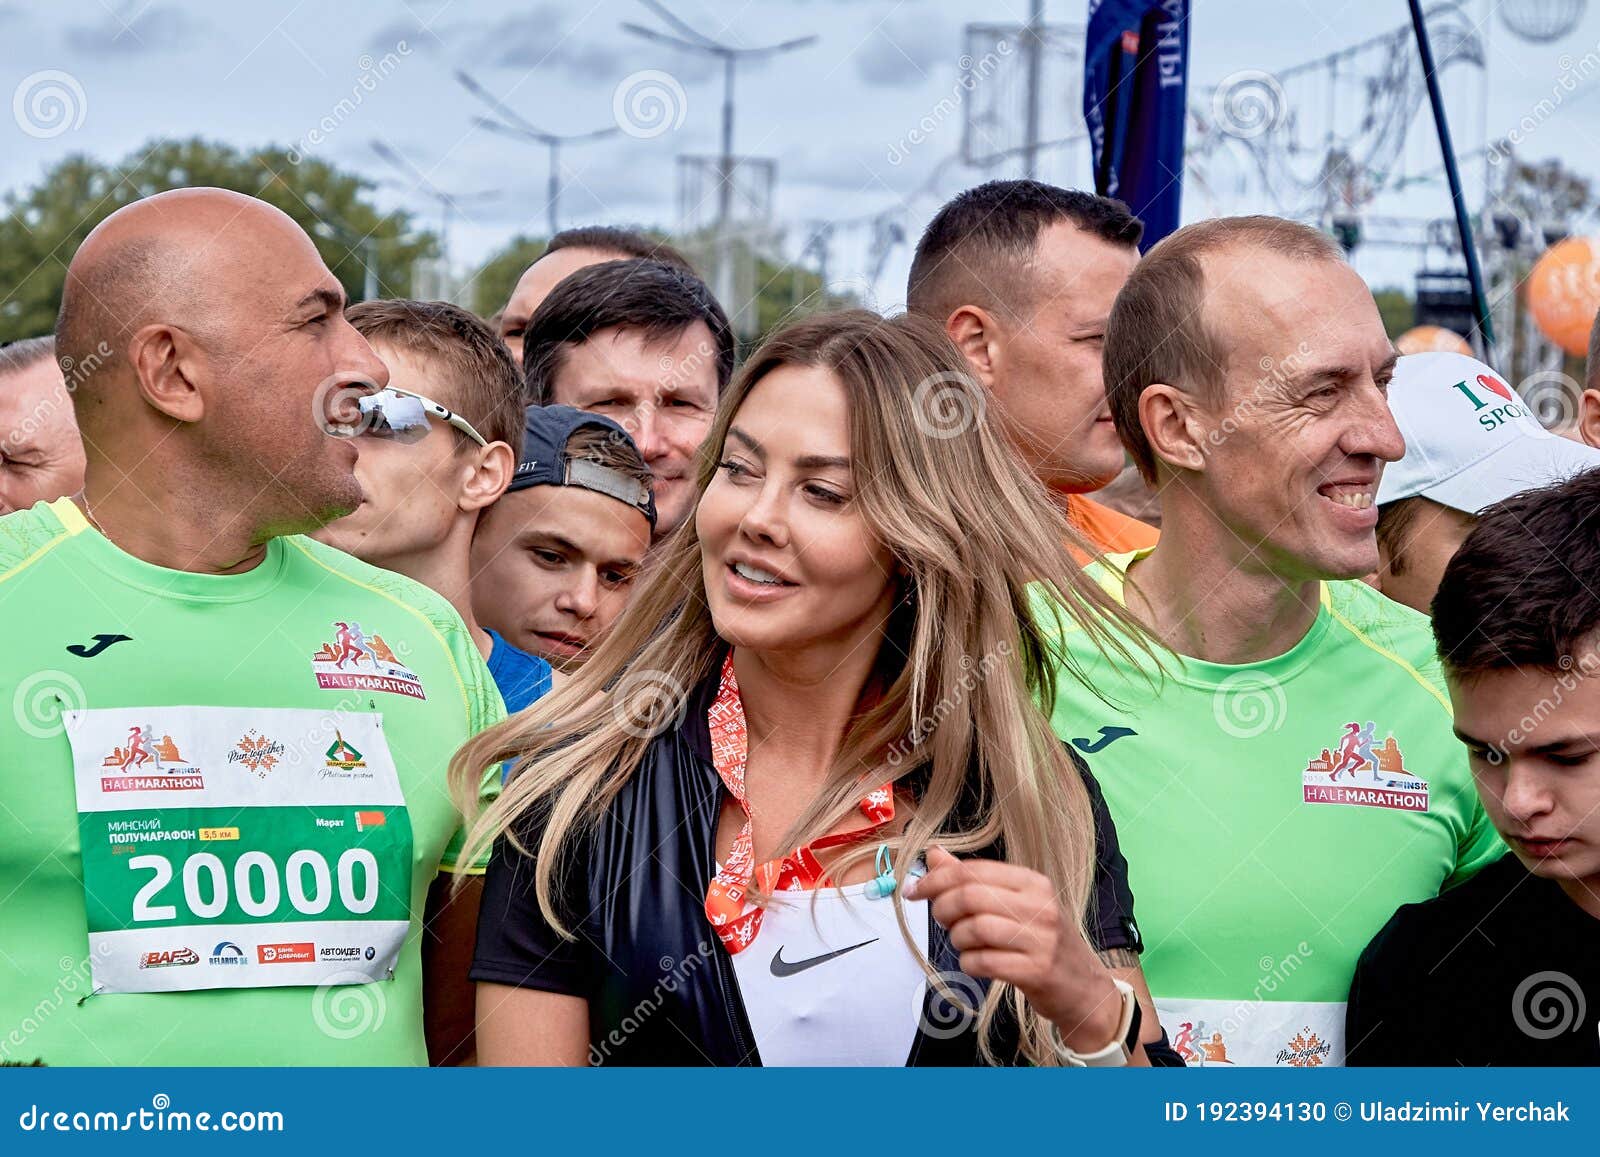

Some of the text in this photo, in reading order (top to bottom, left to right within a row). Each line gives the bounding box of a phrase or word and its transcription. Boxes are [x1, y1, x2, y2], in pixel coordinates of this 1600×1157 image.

[1453, 380, 1488, 411] I
[518, 461, 537, 472] FIT
[319, 675, 423, 698] HALFMARATHON
[103, 778, 203, 791] HALFMARATHON
[1307, 788, 1426, 809] HALFMARATHON
[108, 818, 161, 832] МИНСКИЙ
[316, 818, 345, 828] Марат
[109, 830, 196, 844] ПОЛУМАРАФОН
[128, 848, 379, 922] 20000
